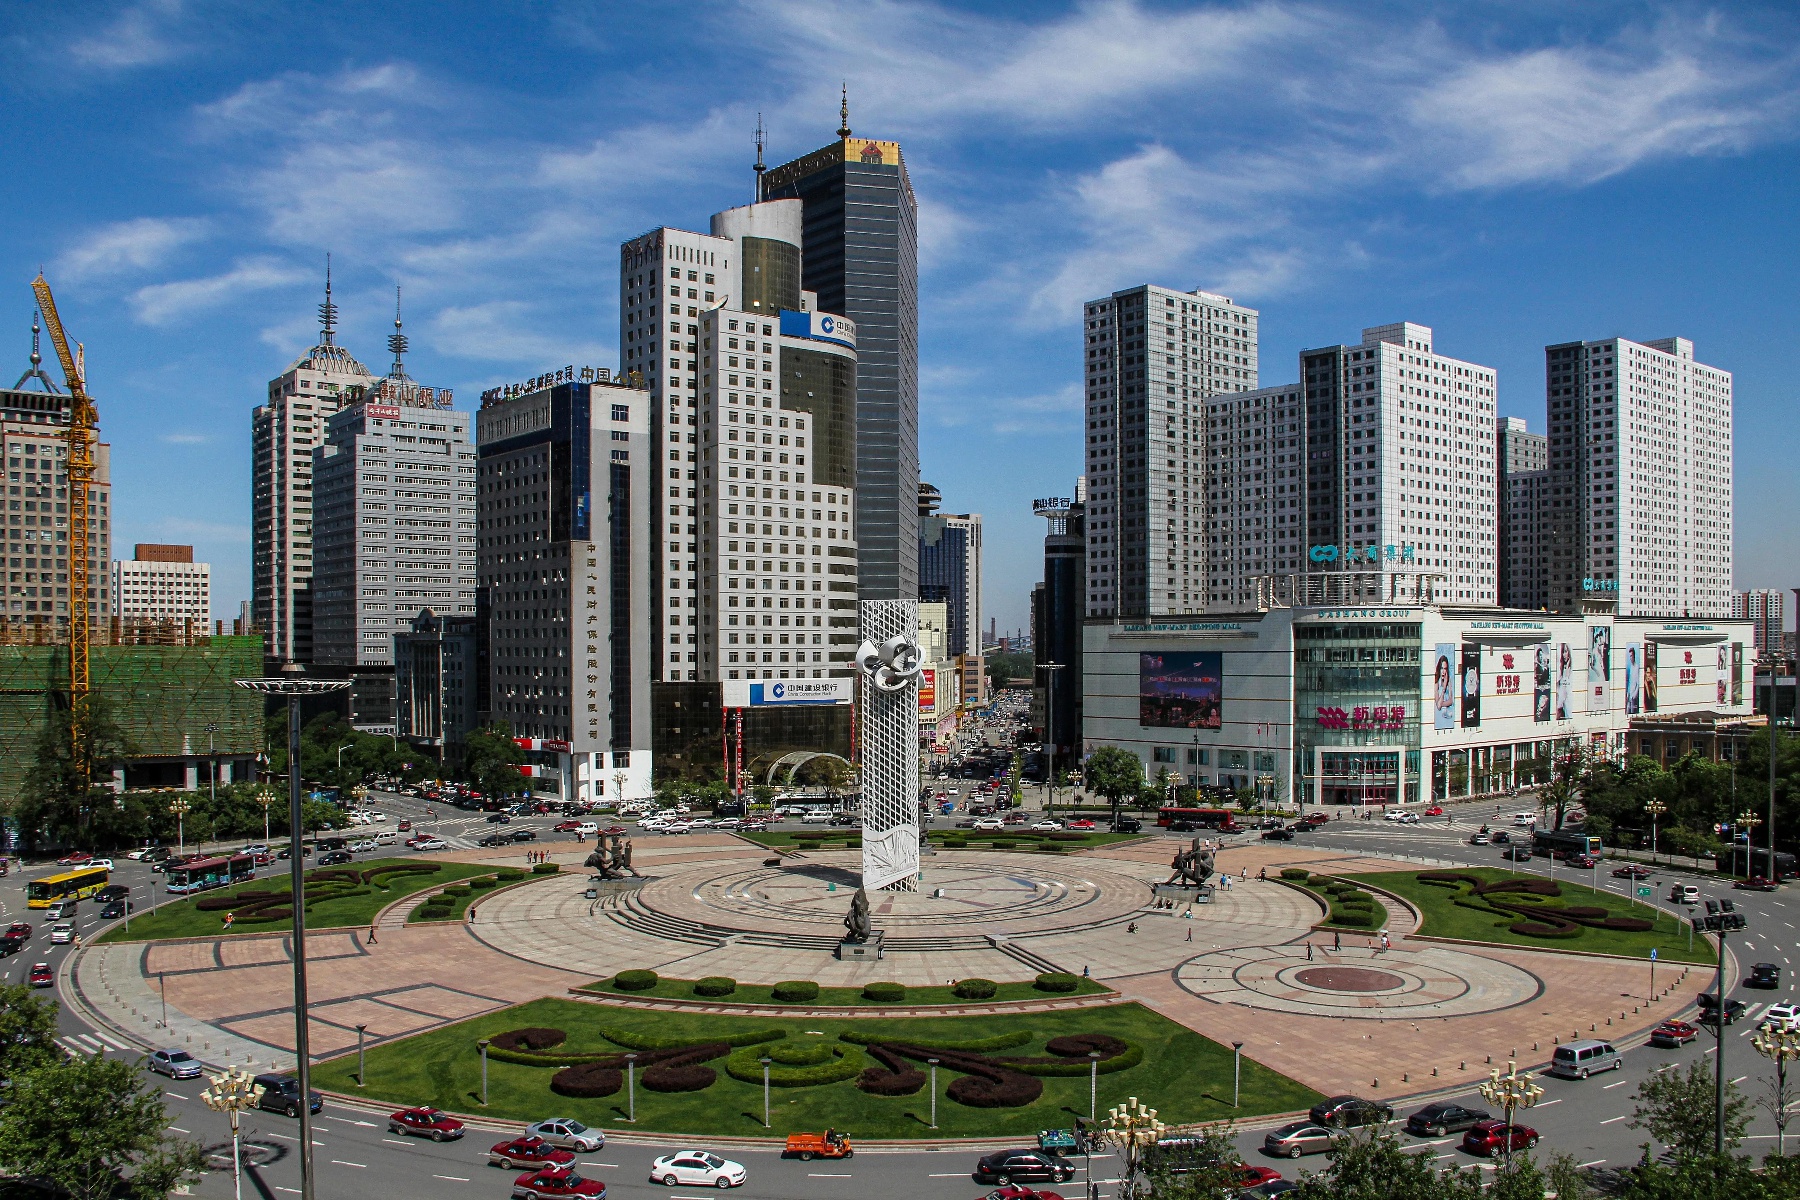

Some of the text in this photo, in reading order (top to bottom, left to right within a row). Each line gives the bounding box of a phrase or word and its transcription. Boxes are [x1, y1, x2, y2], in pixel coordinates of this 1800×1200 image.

[380, 382, 454, 408] 鞍山报业
[1032, 497, 1070, 510] 鞍山银行
[1346, 544, 1414, 561] 大商集团
[1318, 610, 1411, 619] DASHANG GROUP
[1189, 623, 1221, 631] SHOPPING
[586, 543, 598, 740] 中国人民财产保险股份有限公司
[787, 683, 838, 692] 中国建设银行
[1496, 674, 1520, 688] 新玛特
[1353, 706, 1405, 721] 新玛特
